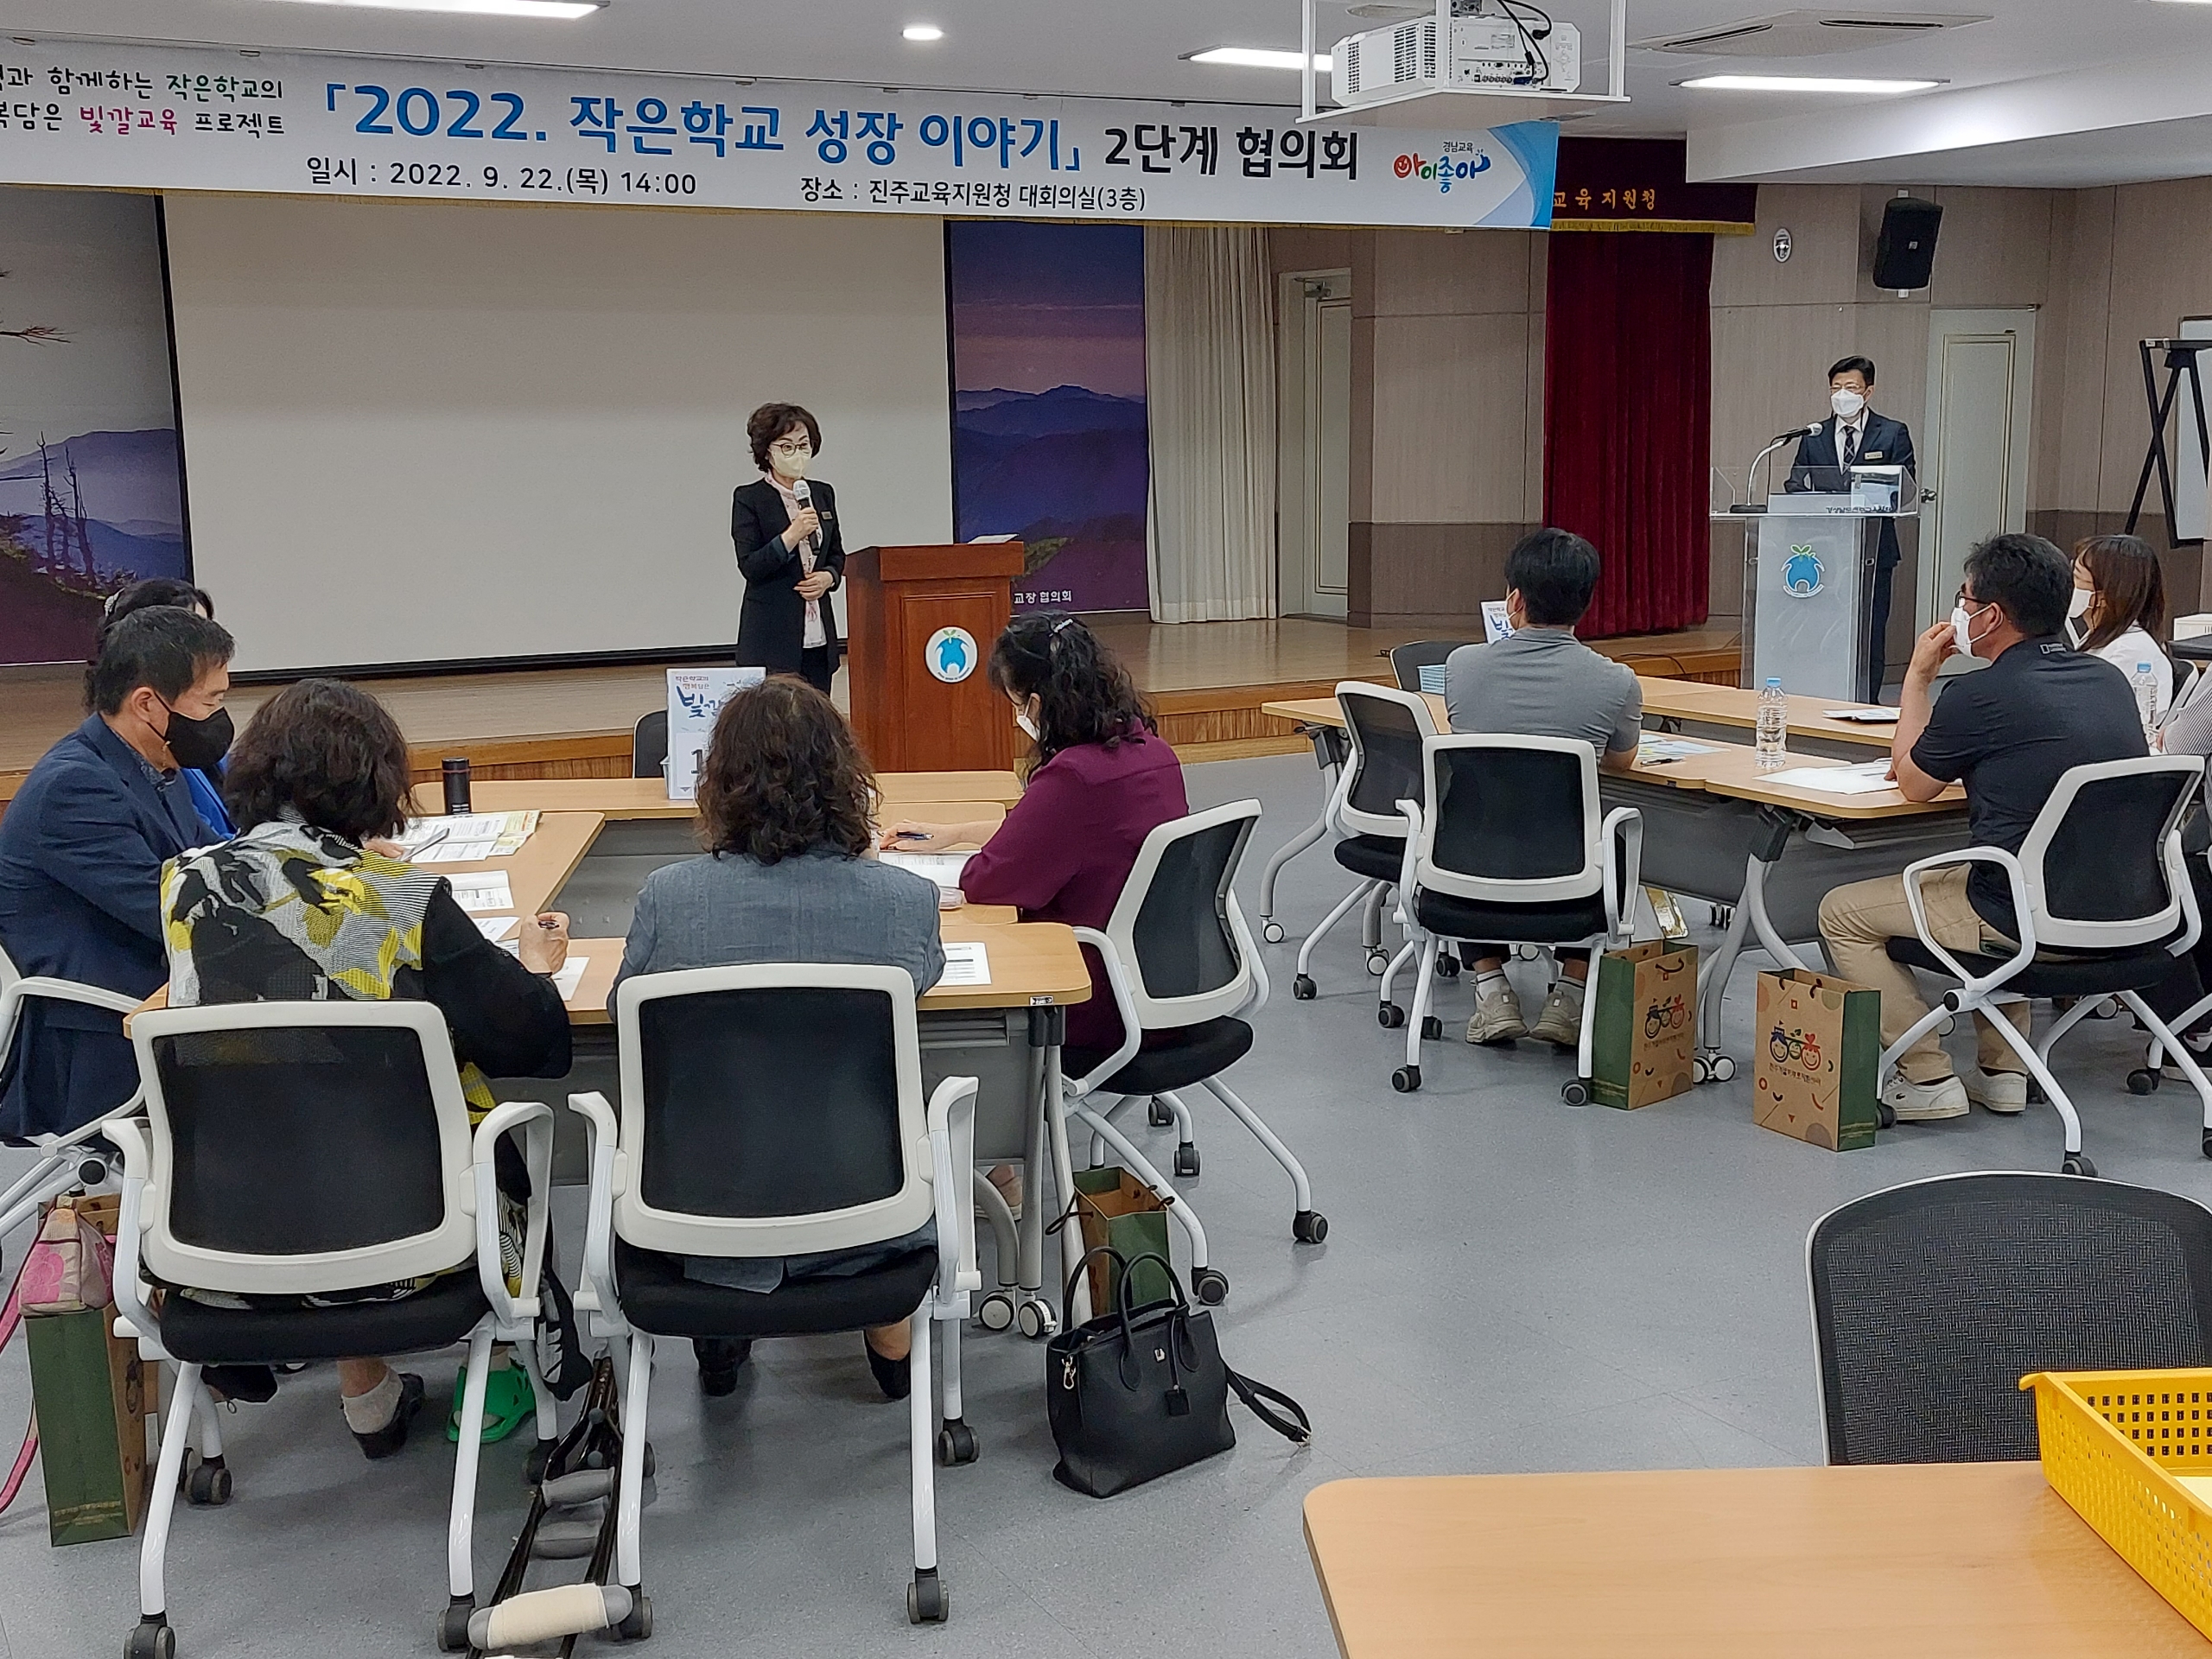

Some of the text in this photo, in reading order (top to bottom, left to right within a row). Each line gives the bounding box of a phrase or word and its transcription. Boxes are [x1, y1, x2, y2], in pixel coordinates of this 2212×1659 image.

[48, 67, 153, 99] 함께하는
[166, 73, 283, 103] 작은학교의
[79, 105, 177, 136] 빛깔교육
[194, 112, 285, 138] 프로젝트
[569, 96, 785, 157] 작은학교
[805, 108, 903, 165] 성장
[1104, 124, 1218, 177] 2단계
[1236, 126, 1358, 181] 협의회
[1442, 141, 1474, 154] 경남교육
[307, 157, 357, 185] 일시
[390, 162, 472, 188] 2022.
[482, 166, 508, 189] 9.
[519, 167, 609, 195] 22.(목)
[620, 171, 696, 195] 14:00
[1394, 152, 1491, 194] 아이좋아
[800, 175, 843, 203] 장소
[868, 180, 1012, 208] 진주교육지원청
[1019, 183, 1146, 213] 대회의실(3층)
[1014, 589, 1072, 604] 교장 협의회
